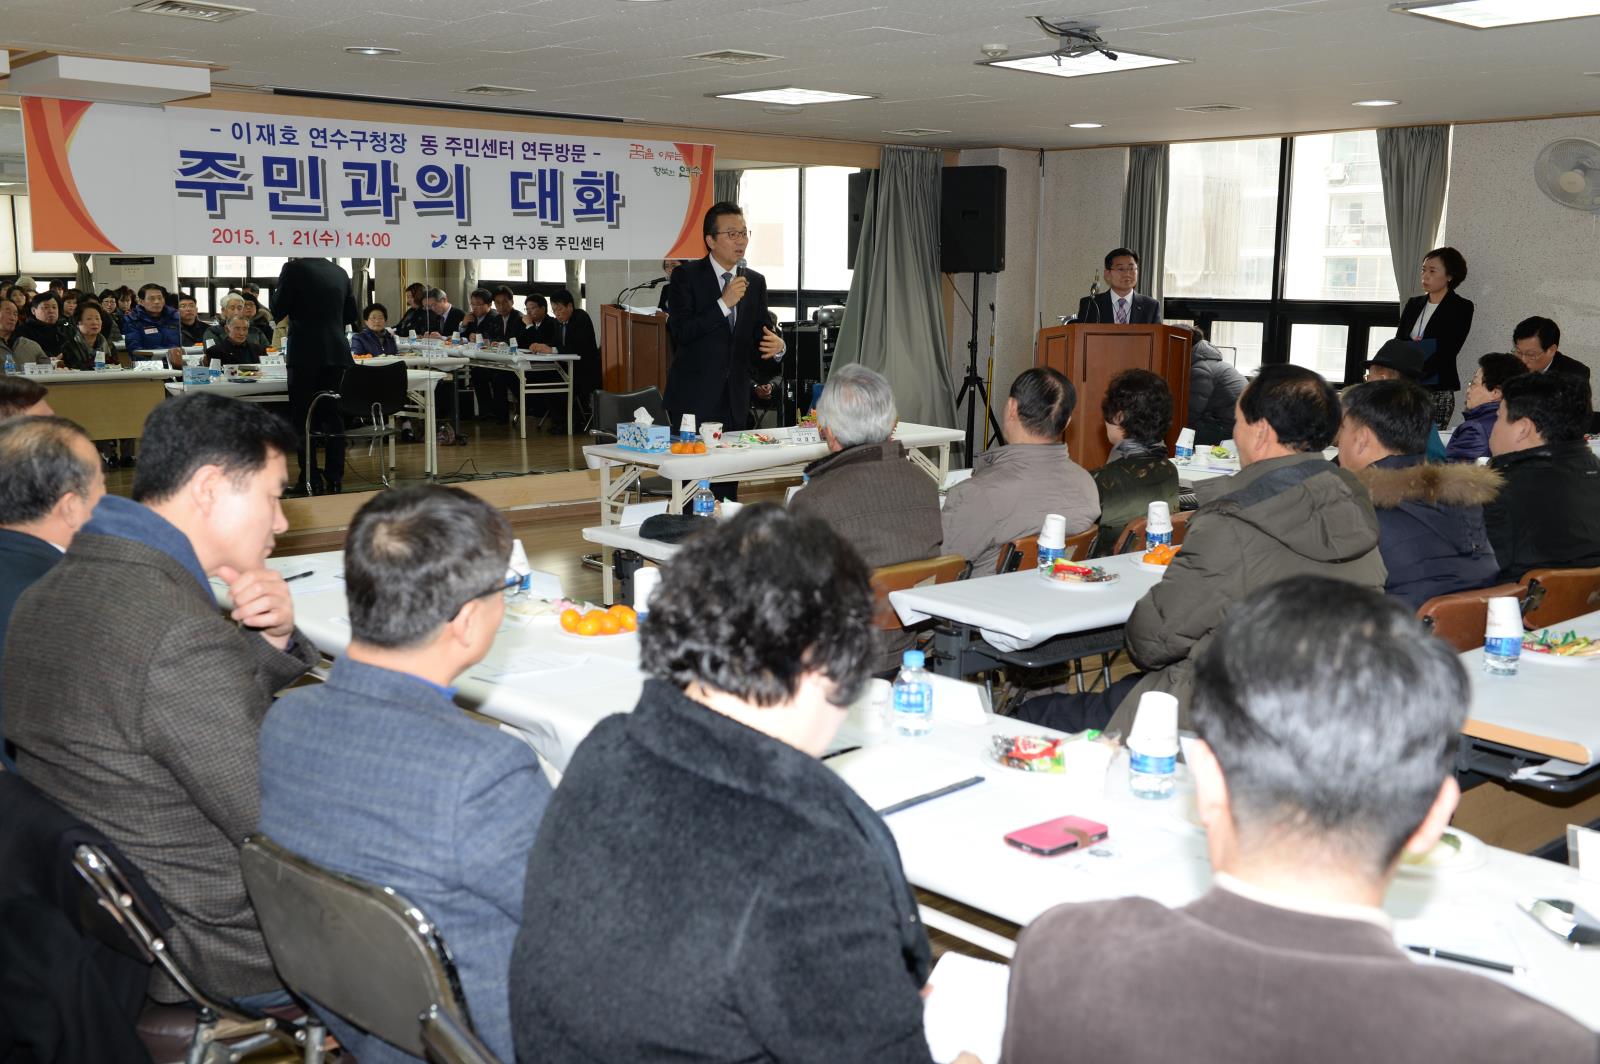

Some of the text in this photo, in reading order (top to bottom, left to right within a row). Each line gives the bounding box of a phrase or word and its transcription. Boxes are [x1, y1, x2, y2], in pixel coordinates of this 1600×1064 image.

[231, 121, 300, 146] 이재호
[309, 127, 407, 154] 연수구청장
[420, 135, 438, 155] 동
[444, 136, 514, 160] 주민센터
[521, 141, 586, 163] 연두방문
[174, 149, 626, 229] 주민과의 대화
[212, 228, 391, 248] 2015. 1. 21(수) 14:00
[454, 234, 604, 251] 연수구 연수3동 주민센터
